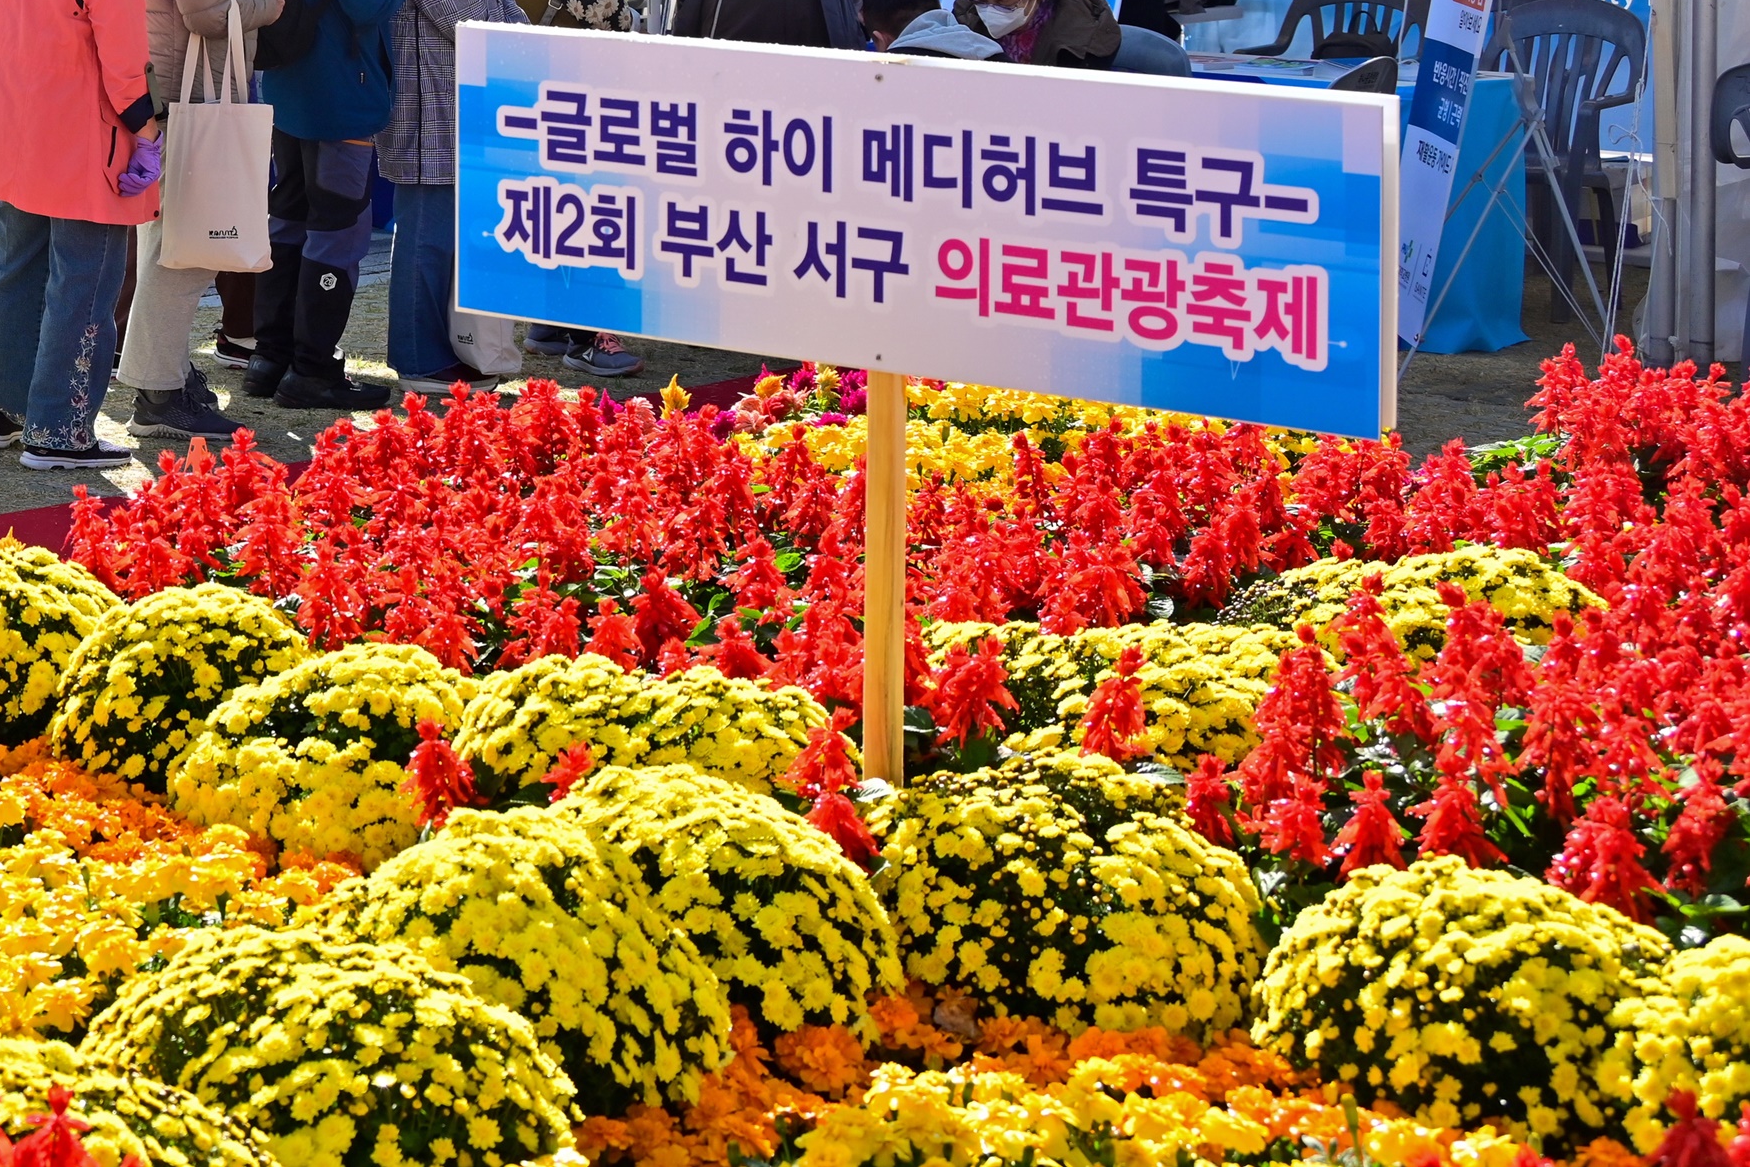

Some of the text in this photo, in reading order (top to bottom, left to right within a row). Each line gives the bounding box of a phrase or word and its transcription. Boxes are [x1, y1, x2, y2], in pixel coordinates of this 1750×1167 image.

[1433, 60, 1457, 89] 반응시간
[722, 107, 835, 196] 하이
[861, 118, 1105, 216] 메디허브
[501, 187, 1320, 362] 제2회 부산 서구 의료관광축제
